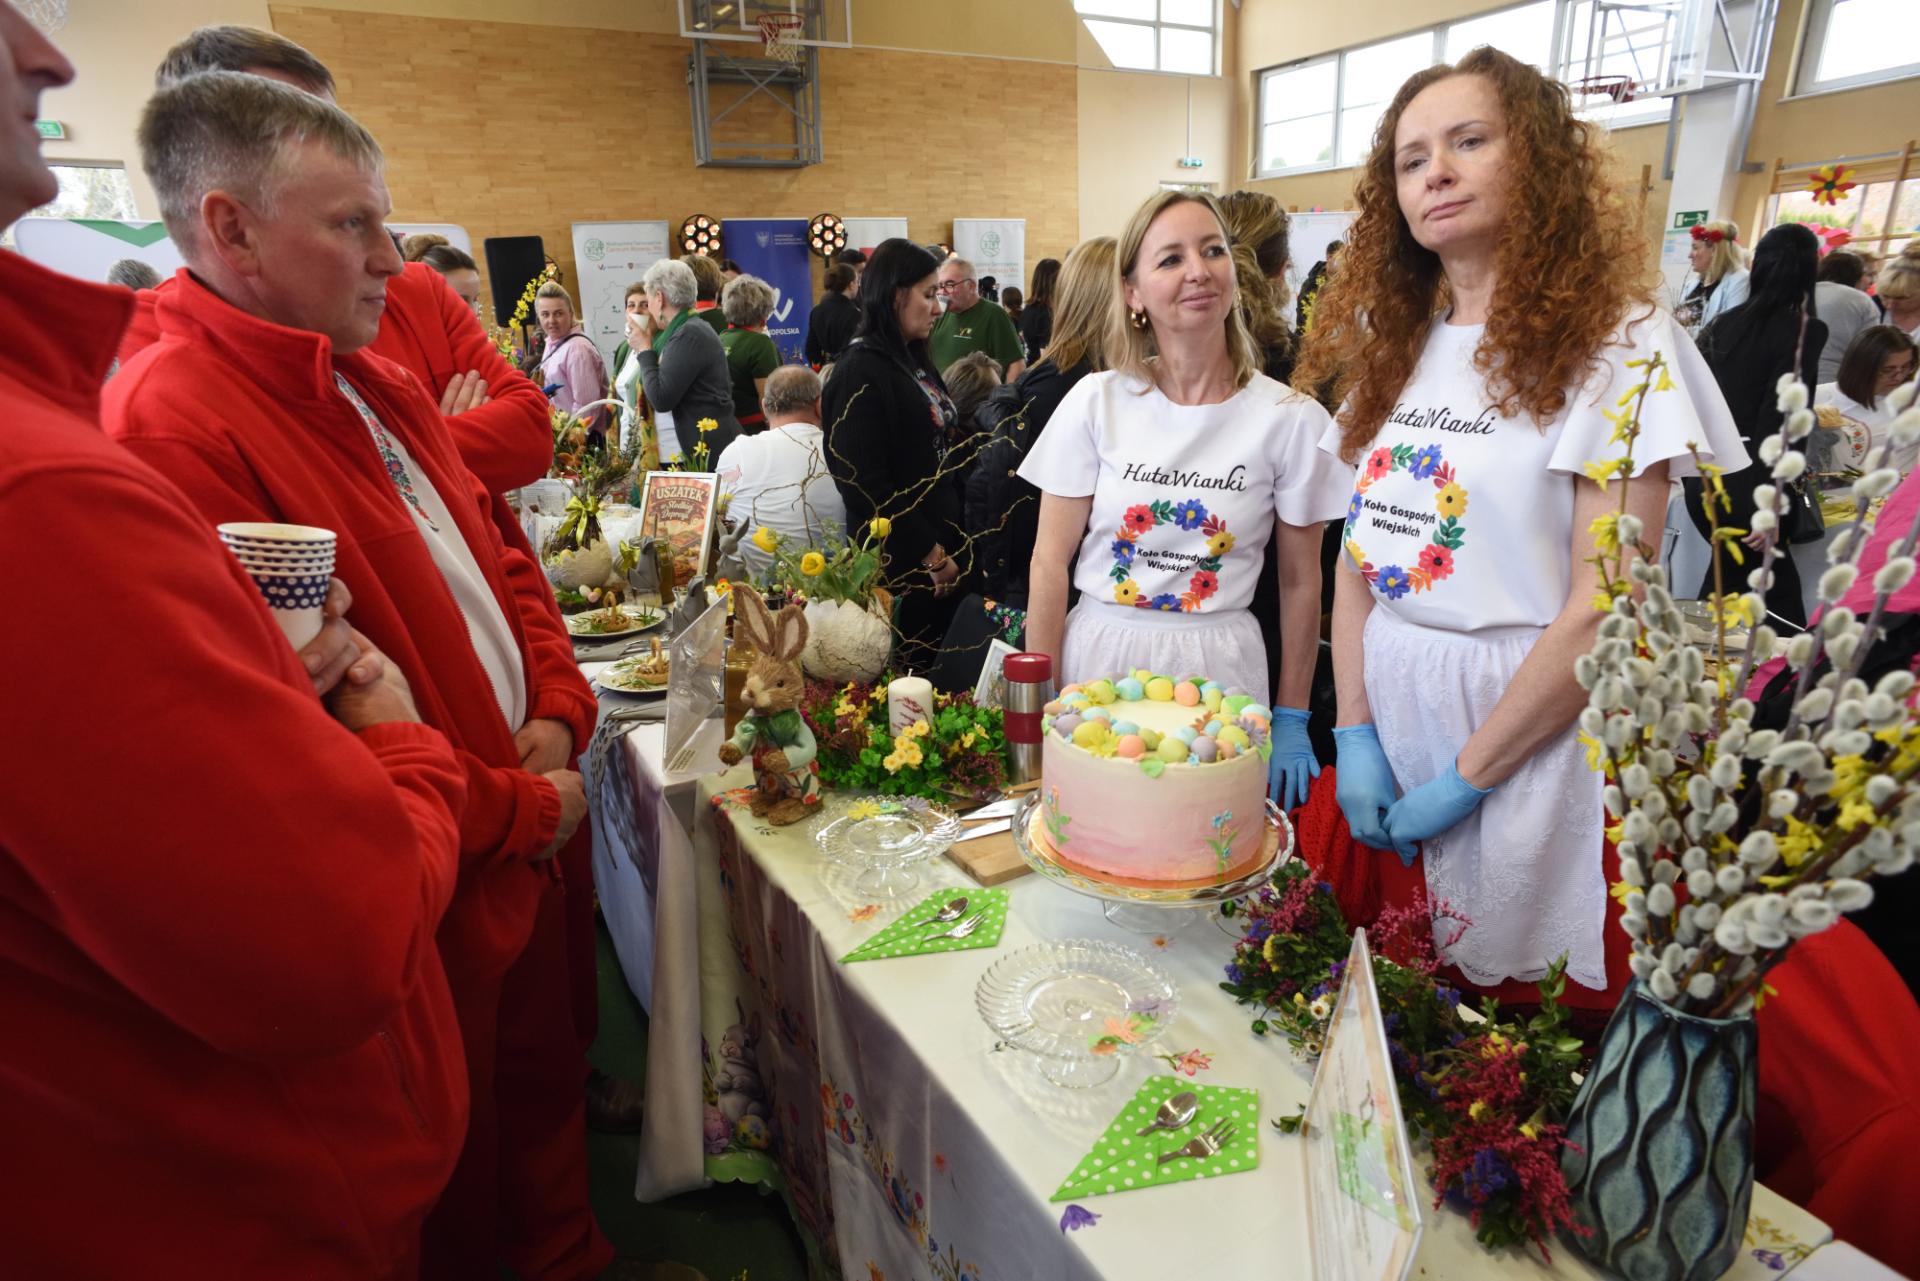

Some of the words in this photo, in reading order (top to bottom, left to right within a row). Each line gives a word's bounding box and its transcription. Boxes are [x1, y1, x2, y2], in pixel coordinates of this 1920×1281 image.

[1123, 463, 1247, 492] HutaWianki
[657, 486, 703, 502] USZATEK
[1364, 498, 1387, 513] Koło
[1390, 505, 1436, 525] Gospodyń
[1372, 517, 1421, 538] Wiejskich
